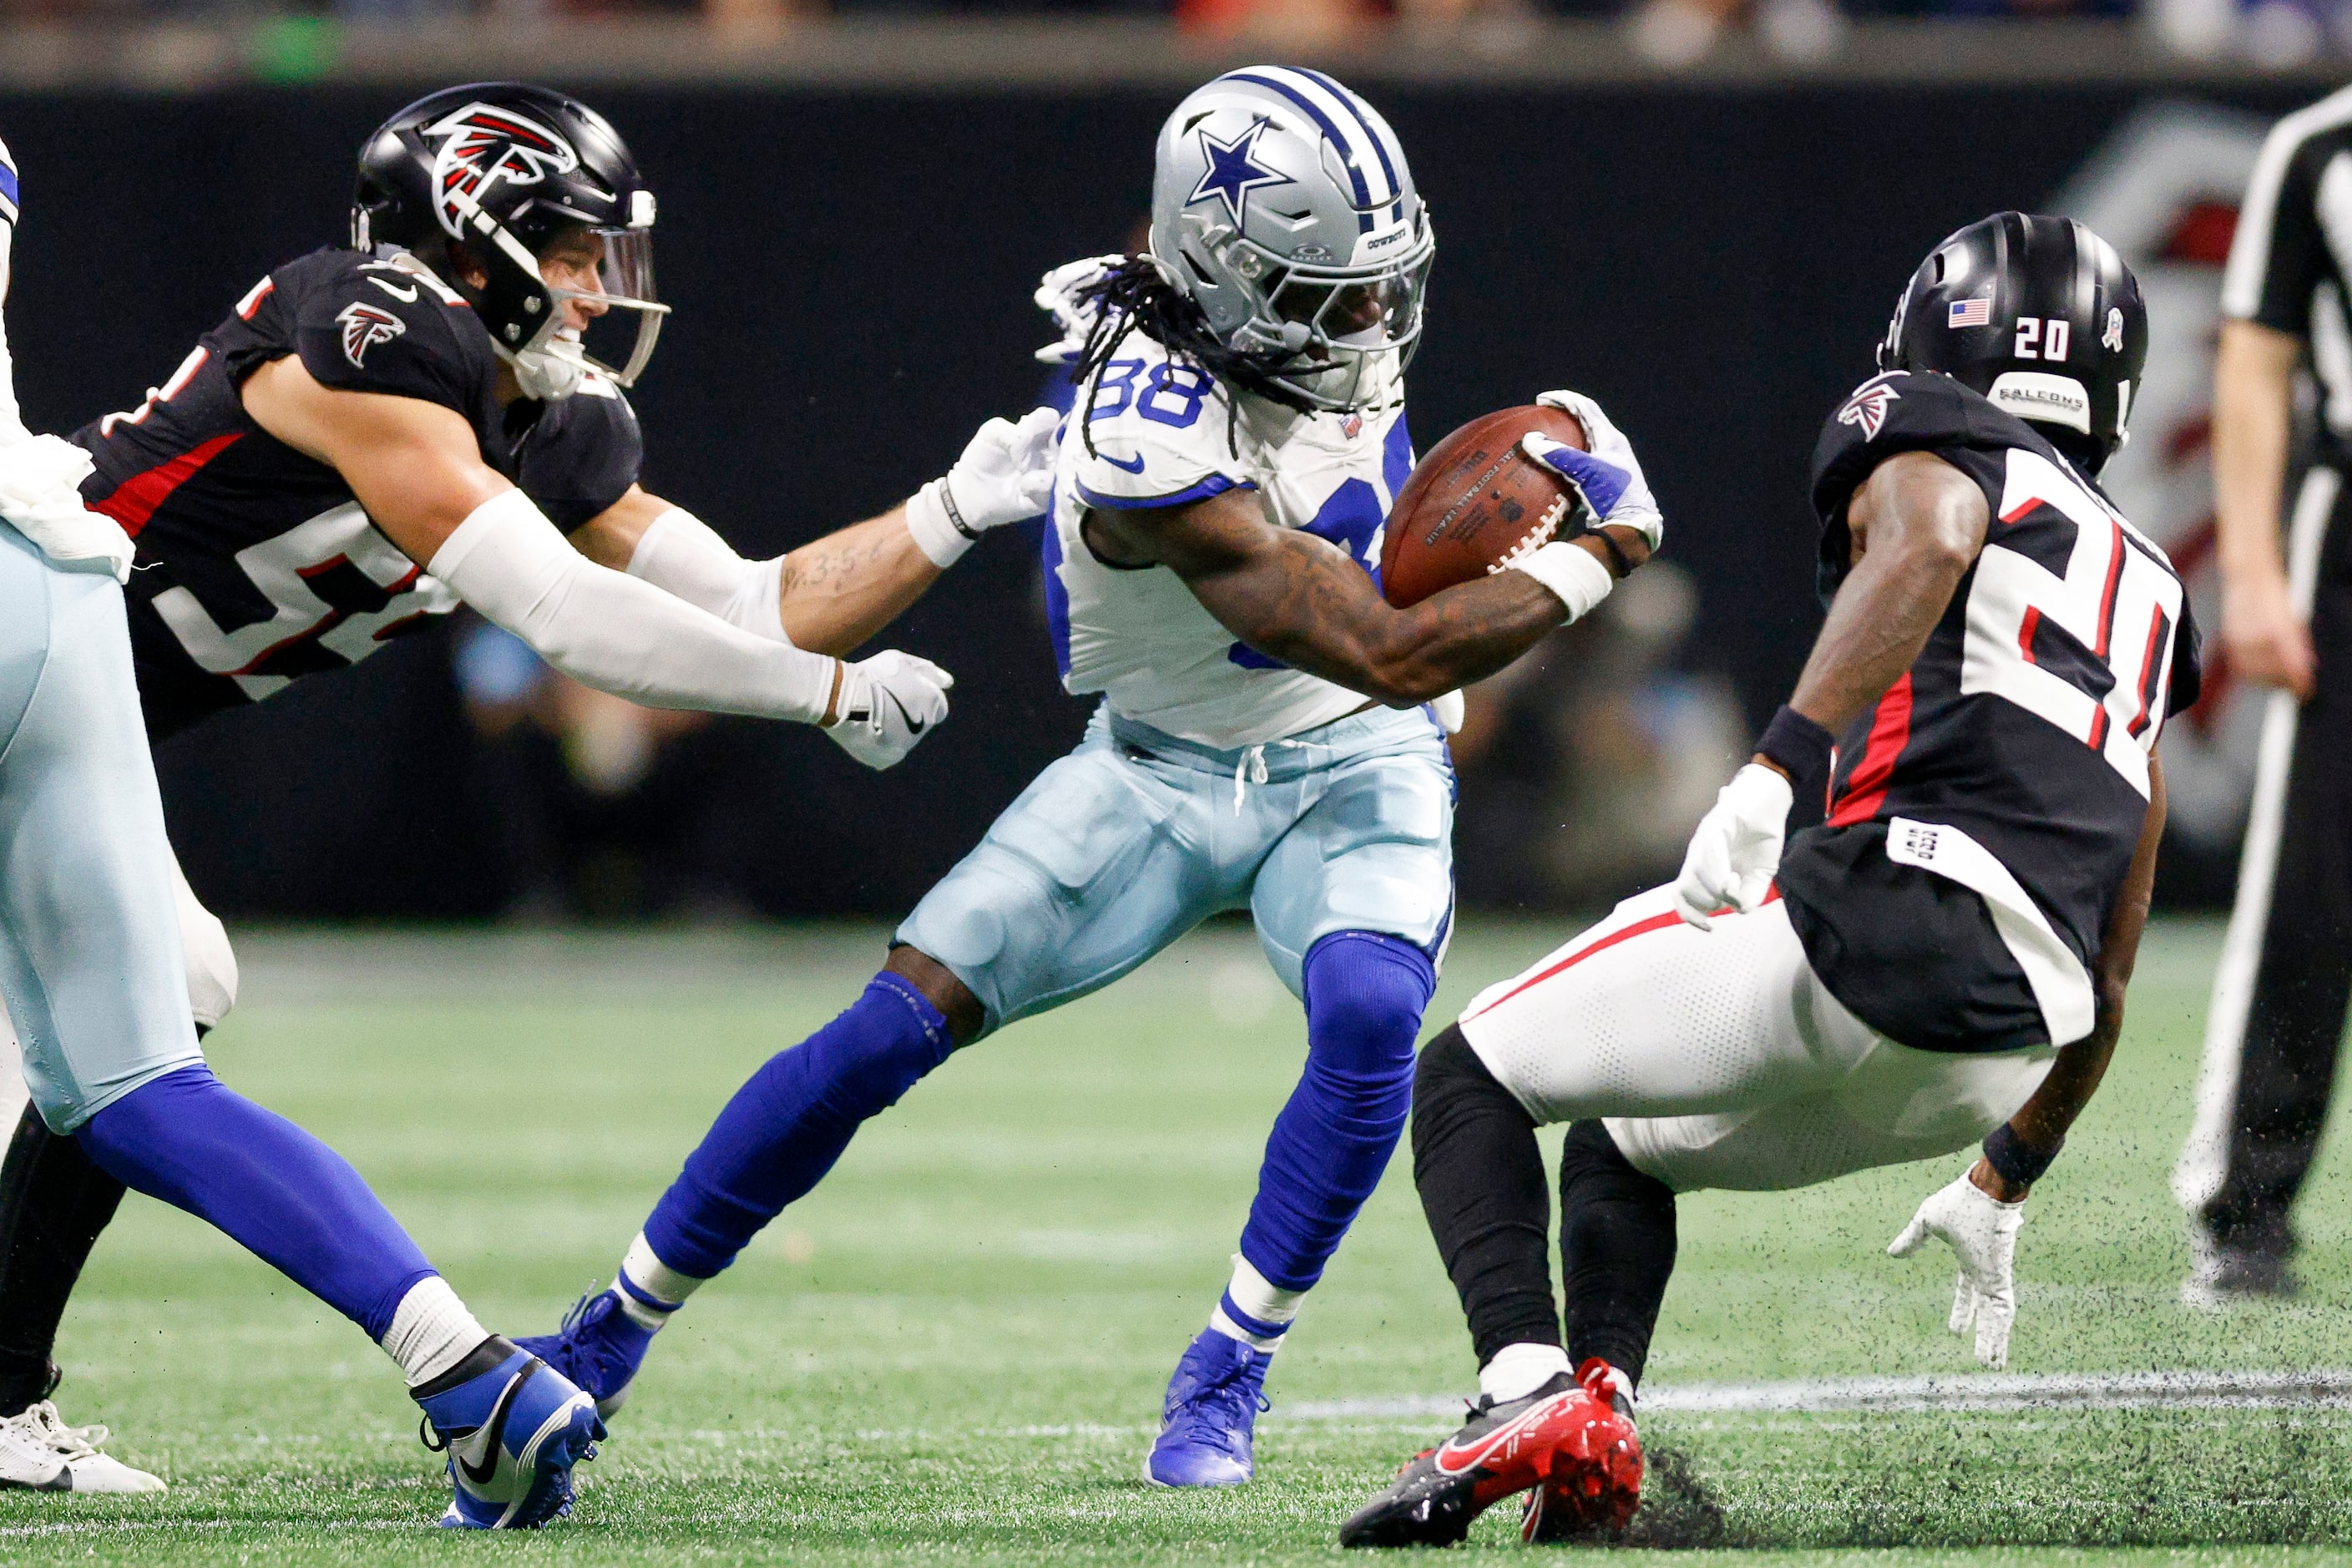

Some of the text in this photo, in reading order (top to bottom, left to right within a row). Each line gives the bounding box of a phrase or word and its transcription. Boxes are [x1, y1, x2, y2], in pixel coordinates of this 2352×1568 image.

[2014, 316, 2071, 362] 20
[2000, 387, 2083, 412] FALCONS
[1960, 447, 2184, 804] 20
